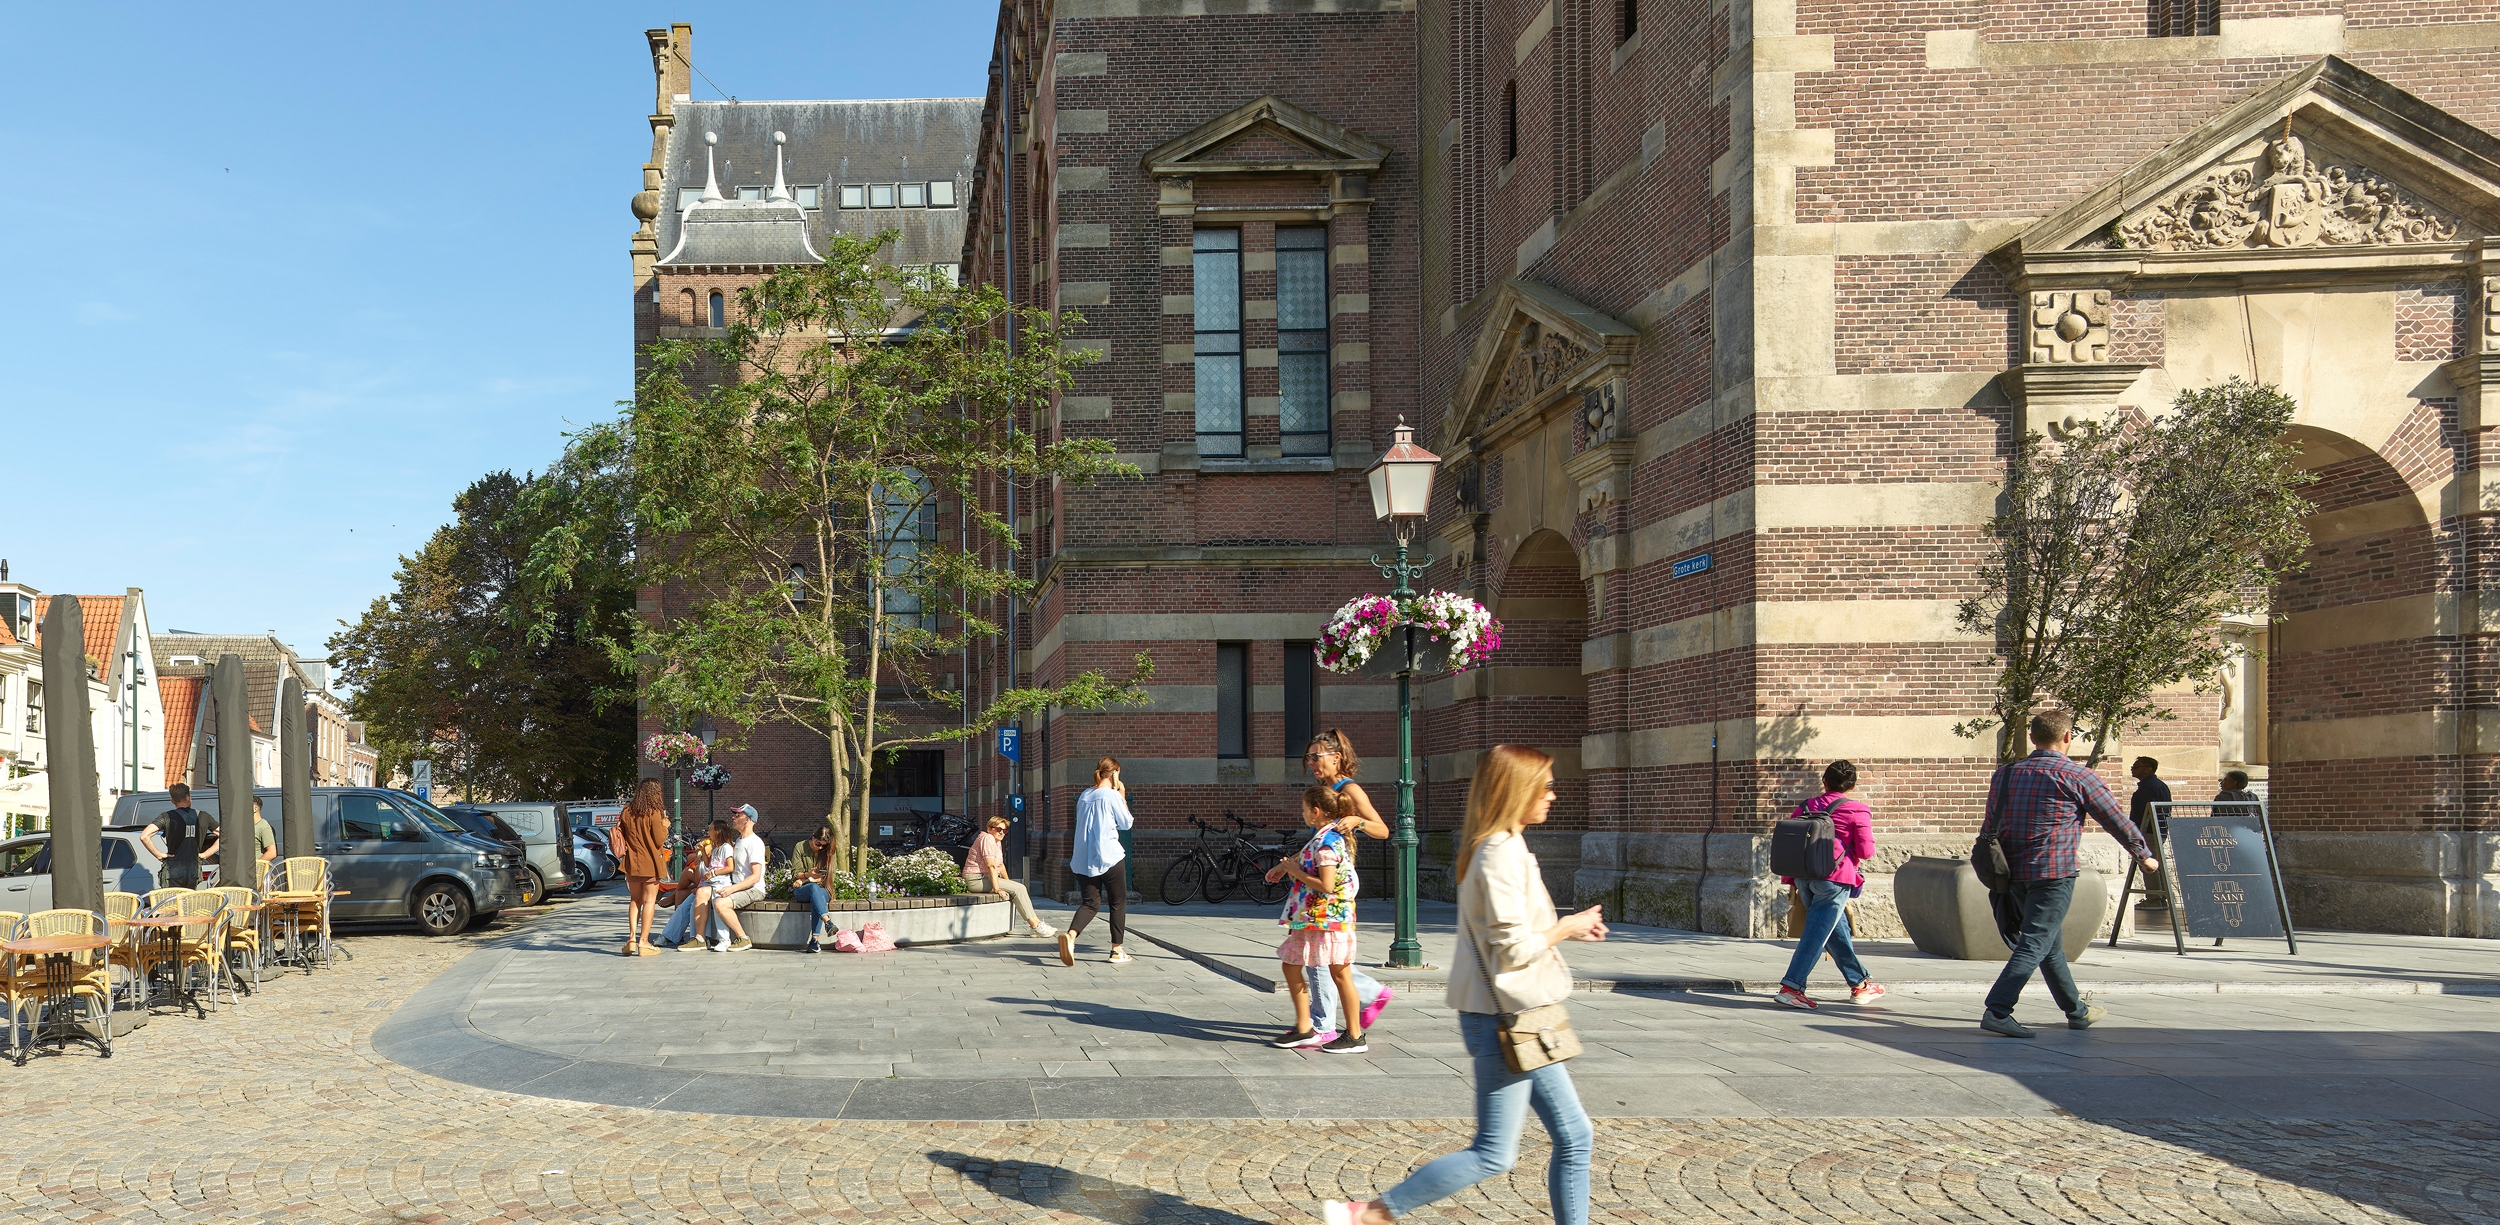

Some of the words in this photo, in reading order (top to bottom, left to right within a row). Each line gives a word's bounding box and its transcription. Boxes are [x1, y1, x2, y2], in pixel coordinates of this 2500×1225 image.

[1674, 564, 1690, 576] Grote
[1691, 558, 1706, 570] kerk
[1003, 737, 1011, 751] P
[419, 788, 426, 796] P
[1014, 797, 1022, 809] P
[600, 815, 616, 823] WIT
[2196, 838, 2238, 846] HEAVENS
[2213, 893, 2244, 901] SAINT
